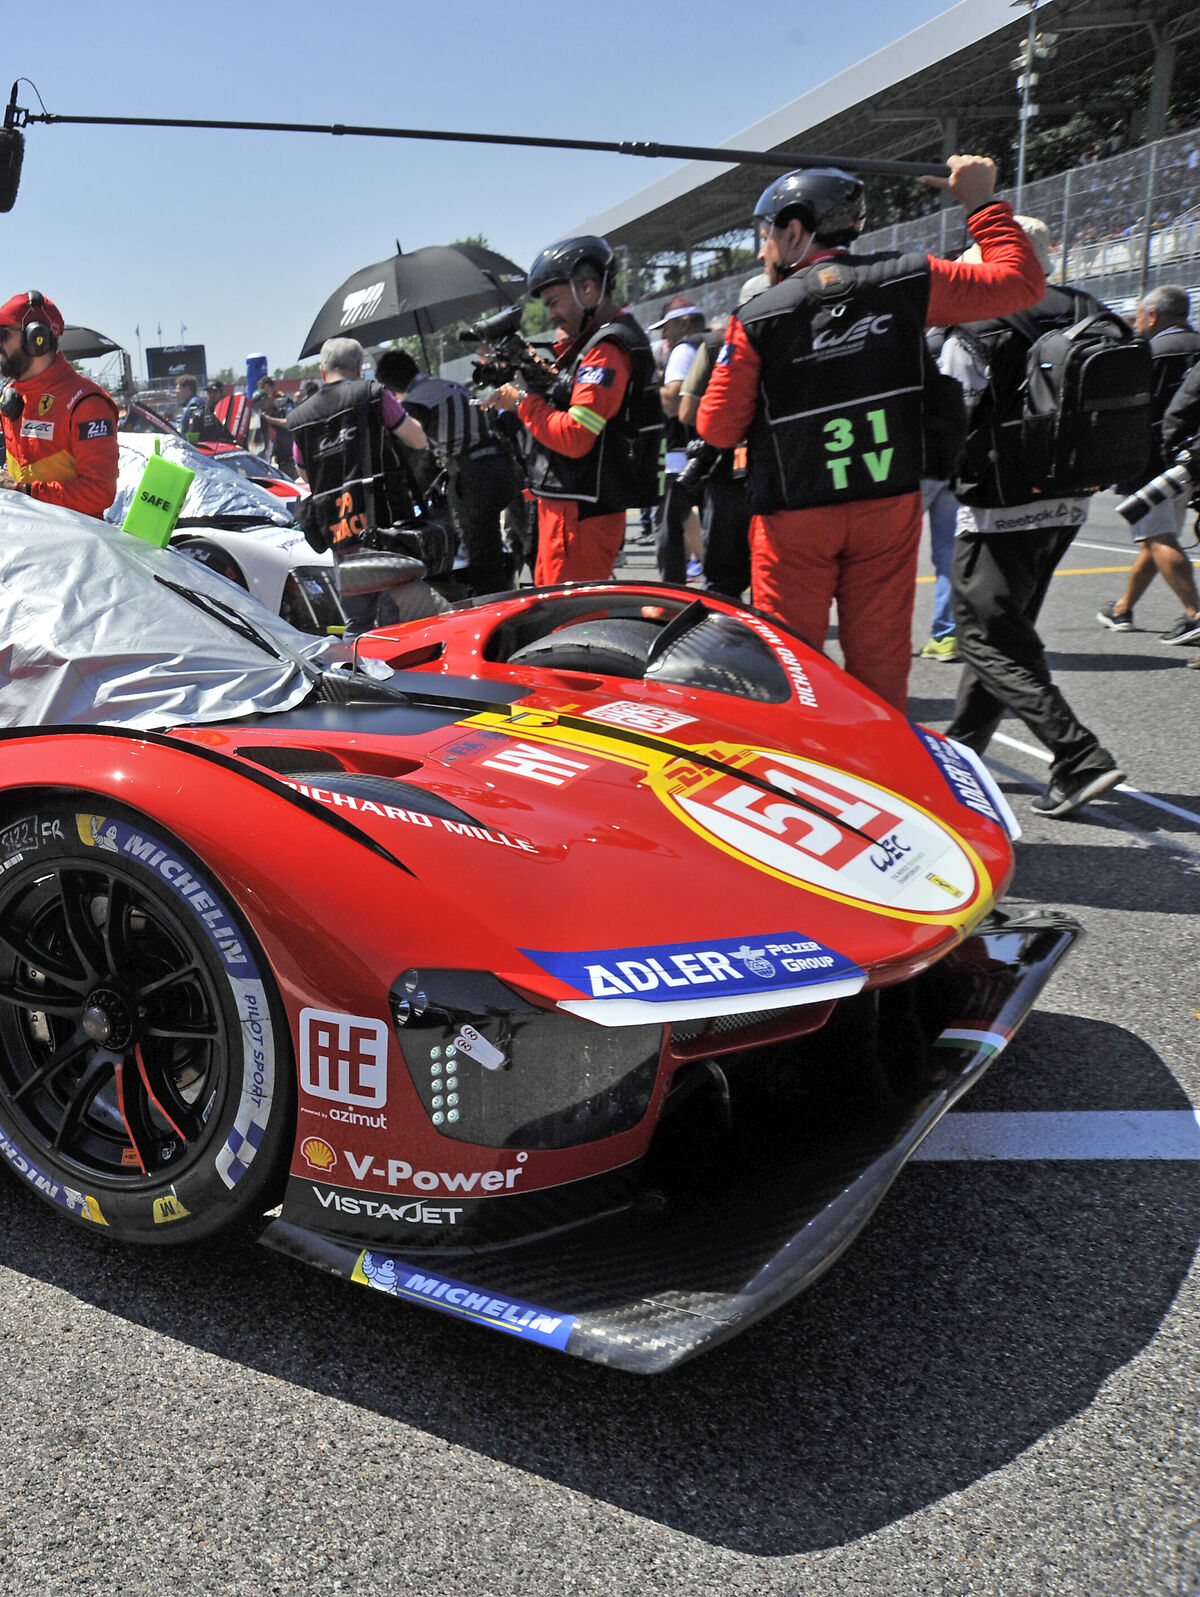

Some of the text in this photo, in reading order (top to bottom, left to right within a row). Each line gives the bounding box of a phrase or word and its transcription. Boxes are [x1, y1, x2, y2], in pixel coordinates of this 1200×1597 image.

[813, 313, 893, 351] WEC
[823, 409, 888, 452] 31
[826, 447, 894, 490] TV
[140, 490, 171, 512] SAFE
[995, 508, 1054, 530] Reebok
[775, 647, 819, 708] RICHARD
[481, 743, 590, 786] HY
[711, 769, 882, 857] 51
[441, 818, 539, 854] MILLE
[869, 834, 912, 873] WEC
[122, 833, 249, 964] MICHELIN
[764, 941, 823, 956] PELZER
[780, 956, 835, 972] GROUP
[584, 951, 744, 997] ADLER
[244, 993, 265, 1109] PILOT SPORT
[329, 1105, 388, 1130] azimut
[343, 1150, 524, 1192] V-Power
[404, 1273, 562, 1335] MICHELIN
